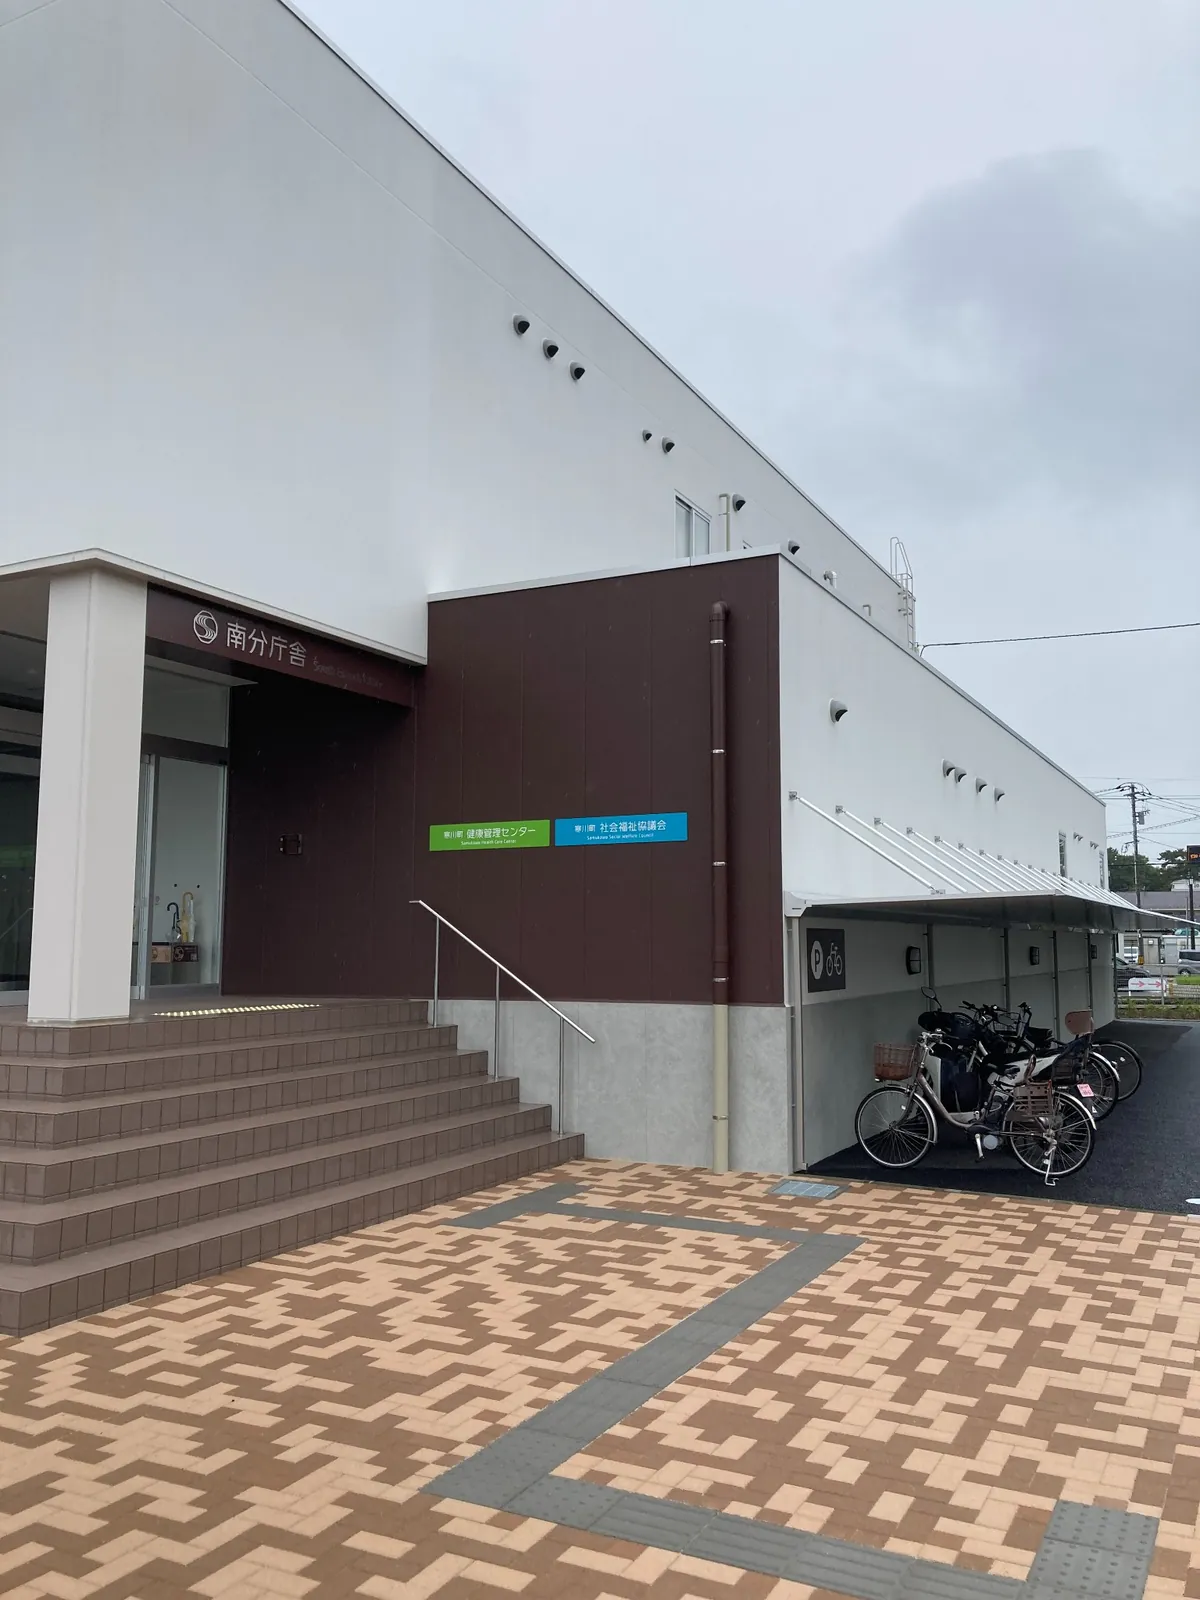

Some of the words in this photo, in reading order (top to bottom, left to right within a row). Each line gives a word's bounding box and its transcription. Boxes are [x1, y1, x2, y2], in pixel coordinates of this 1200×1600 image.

[226, 622, 307, 667] 南分庁舎
[466, 826, 536, 839] 健康管理センター
[600, 819, 666, 833] 社会福祉協議会
